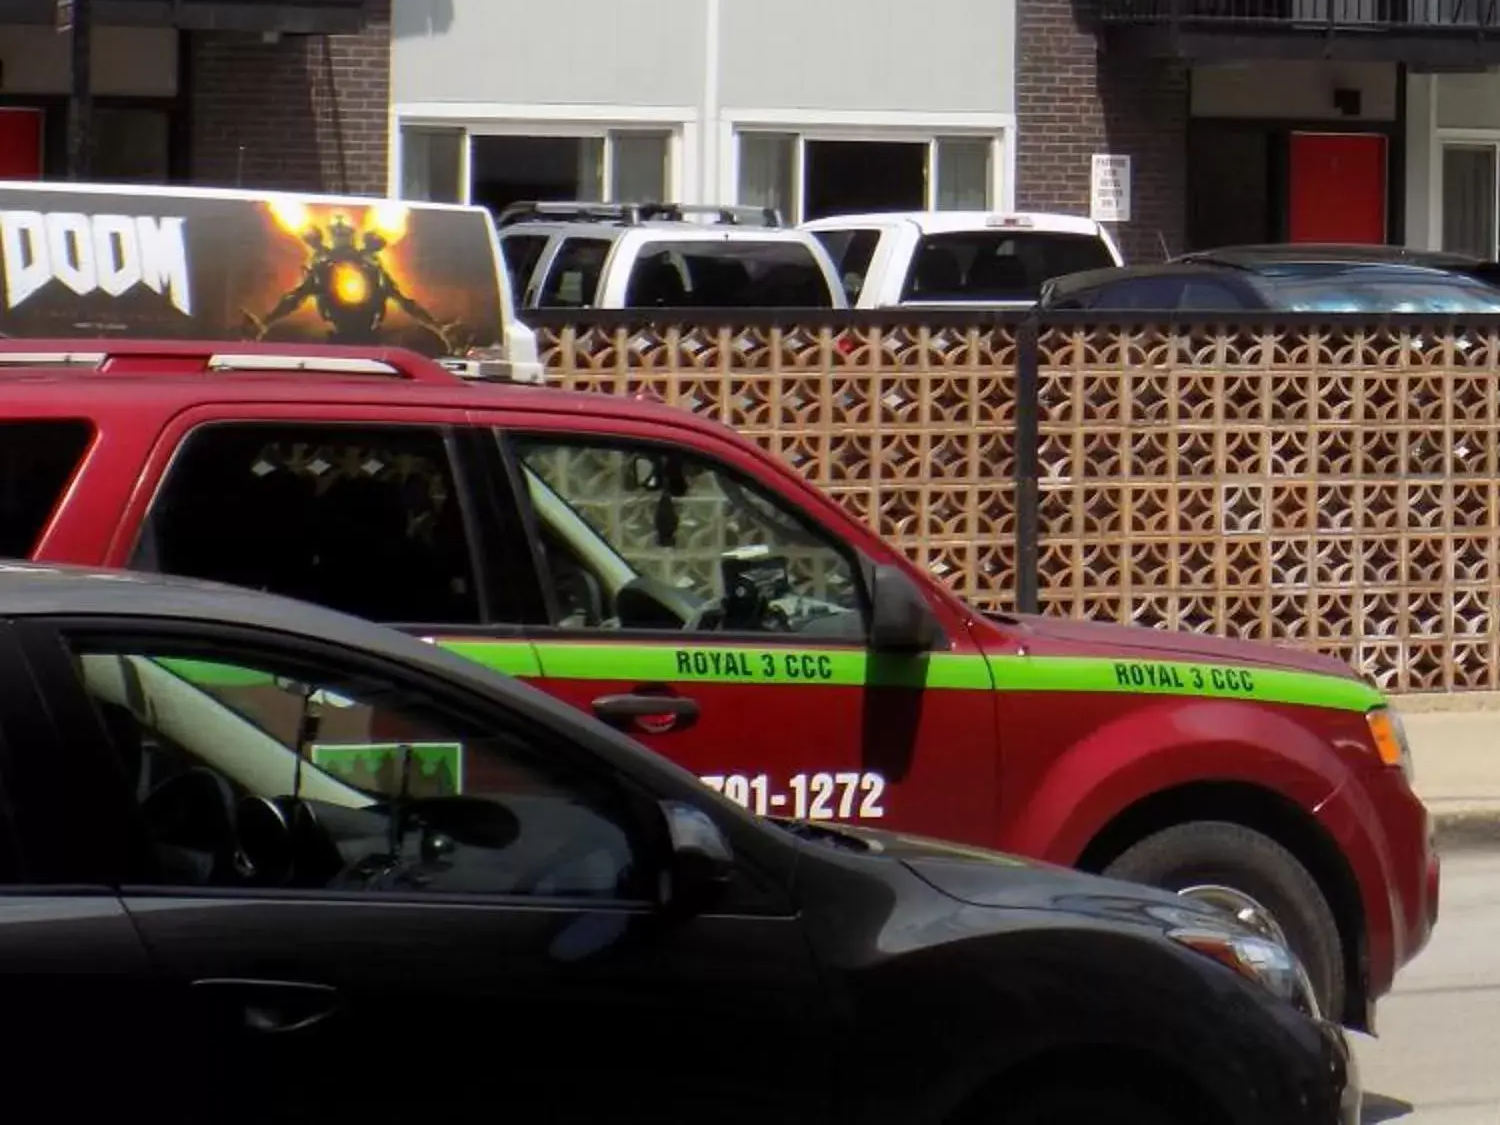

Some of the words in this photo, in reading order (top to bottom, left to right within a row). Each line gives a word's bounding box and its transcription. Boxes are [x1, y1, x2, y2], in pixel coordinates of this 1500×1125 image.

[0, 210, 191, 317] DOOM
[676, 650, 753, 676] ROYAL
[761, 653, 776, 678] 3
[784, 654, 832, 679] CCC
[1114, 663, 1184, 688] ROYAL
[1190, 667, 1205, 690] 3
[1211, 669, 1254, 692] CCC
